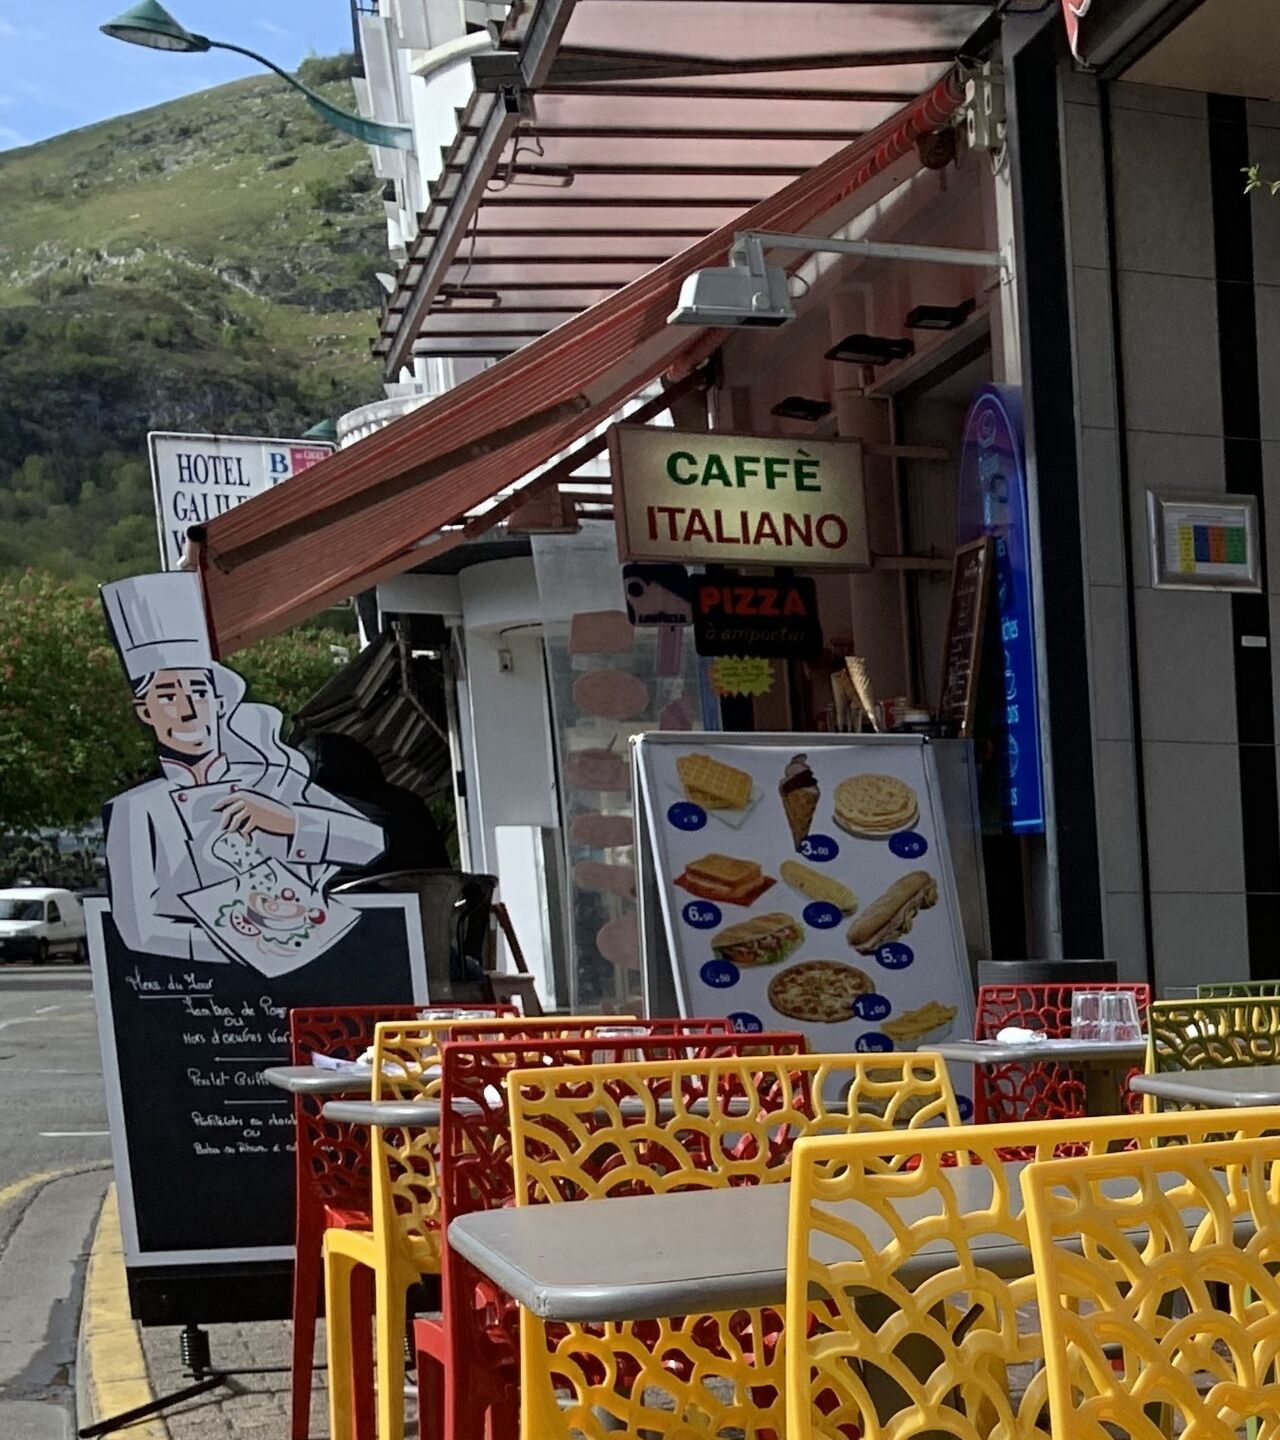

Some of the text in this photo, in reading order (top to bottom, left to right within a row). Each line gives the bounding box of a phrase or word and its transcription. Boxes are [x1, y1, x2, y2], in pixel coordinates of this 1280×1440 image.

[176, 453, 251, 487] HOTEL
[666, 448, 822, 492] CAFFÈ
[647, 505, 848, 549] ITALIANO
[699, 585, 808, 617] PIZZA
